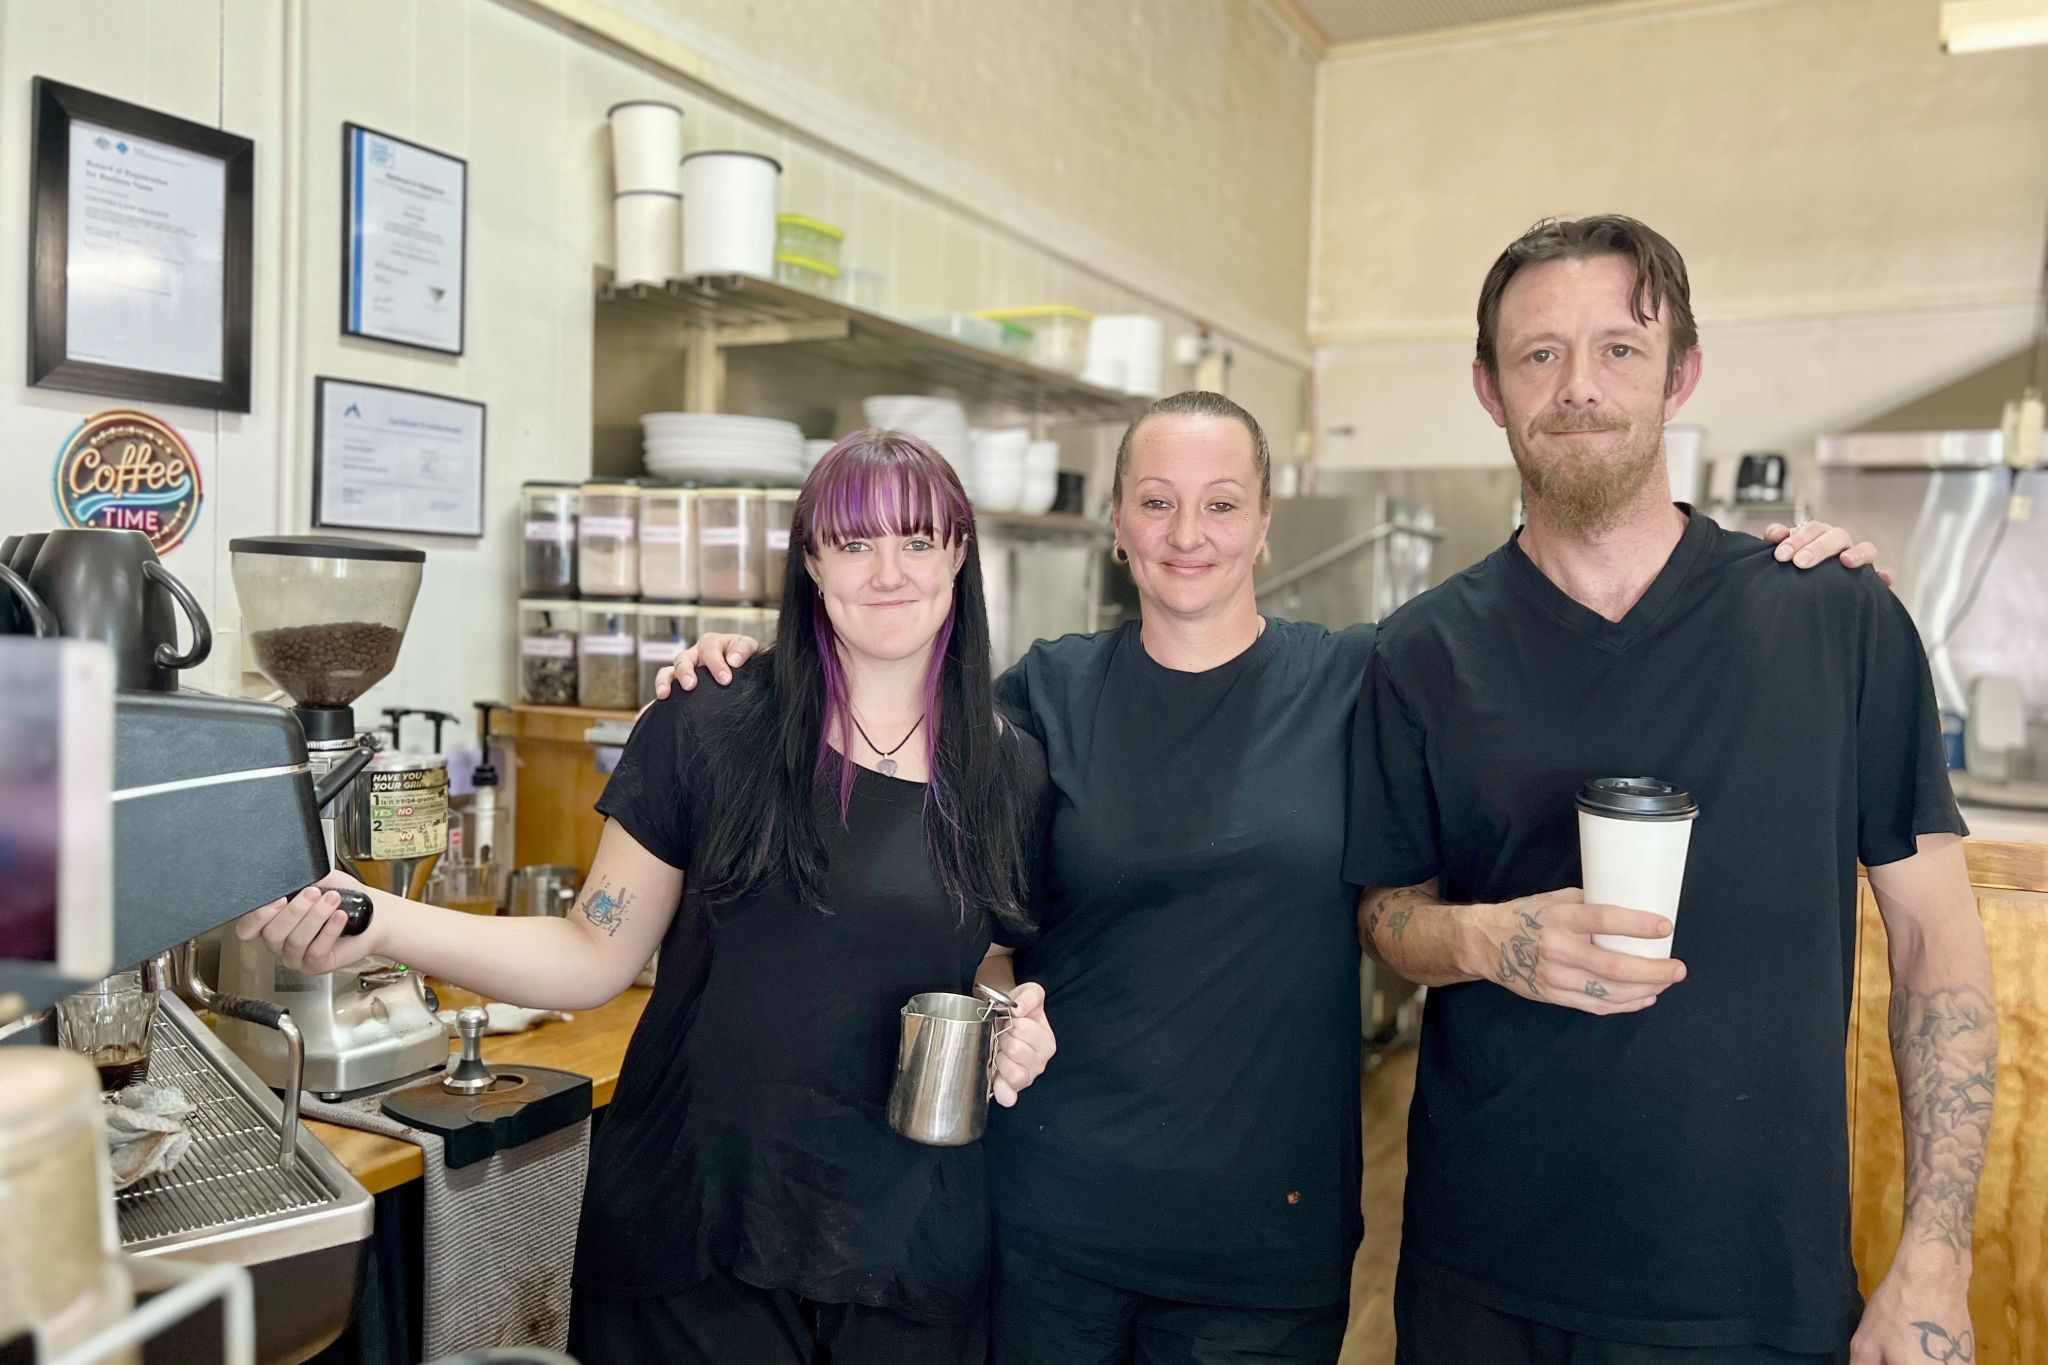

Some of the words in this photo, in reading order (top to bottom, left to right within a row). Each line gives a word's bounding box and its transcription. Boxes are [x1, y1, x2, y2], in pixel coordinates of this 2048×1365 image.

[69, 444, 185, 499] Coffee
[102, 507, 159, 531] TIME
[373, 774, 400, 782] HAVE
[372, 782, 401, 791] YOUR
[373, 795, 379, 805] 1
[374, 809, 393, 817] YES
[397, 808, 413, 816] NO
[373, 820, 383, 832] 2
